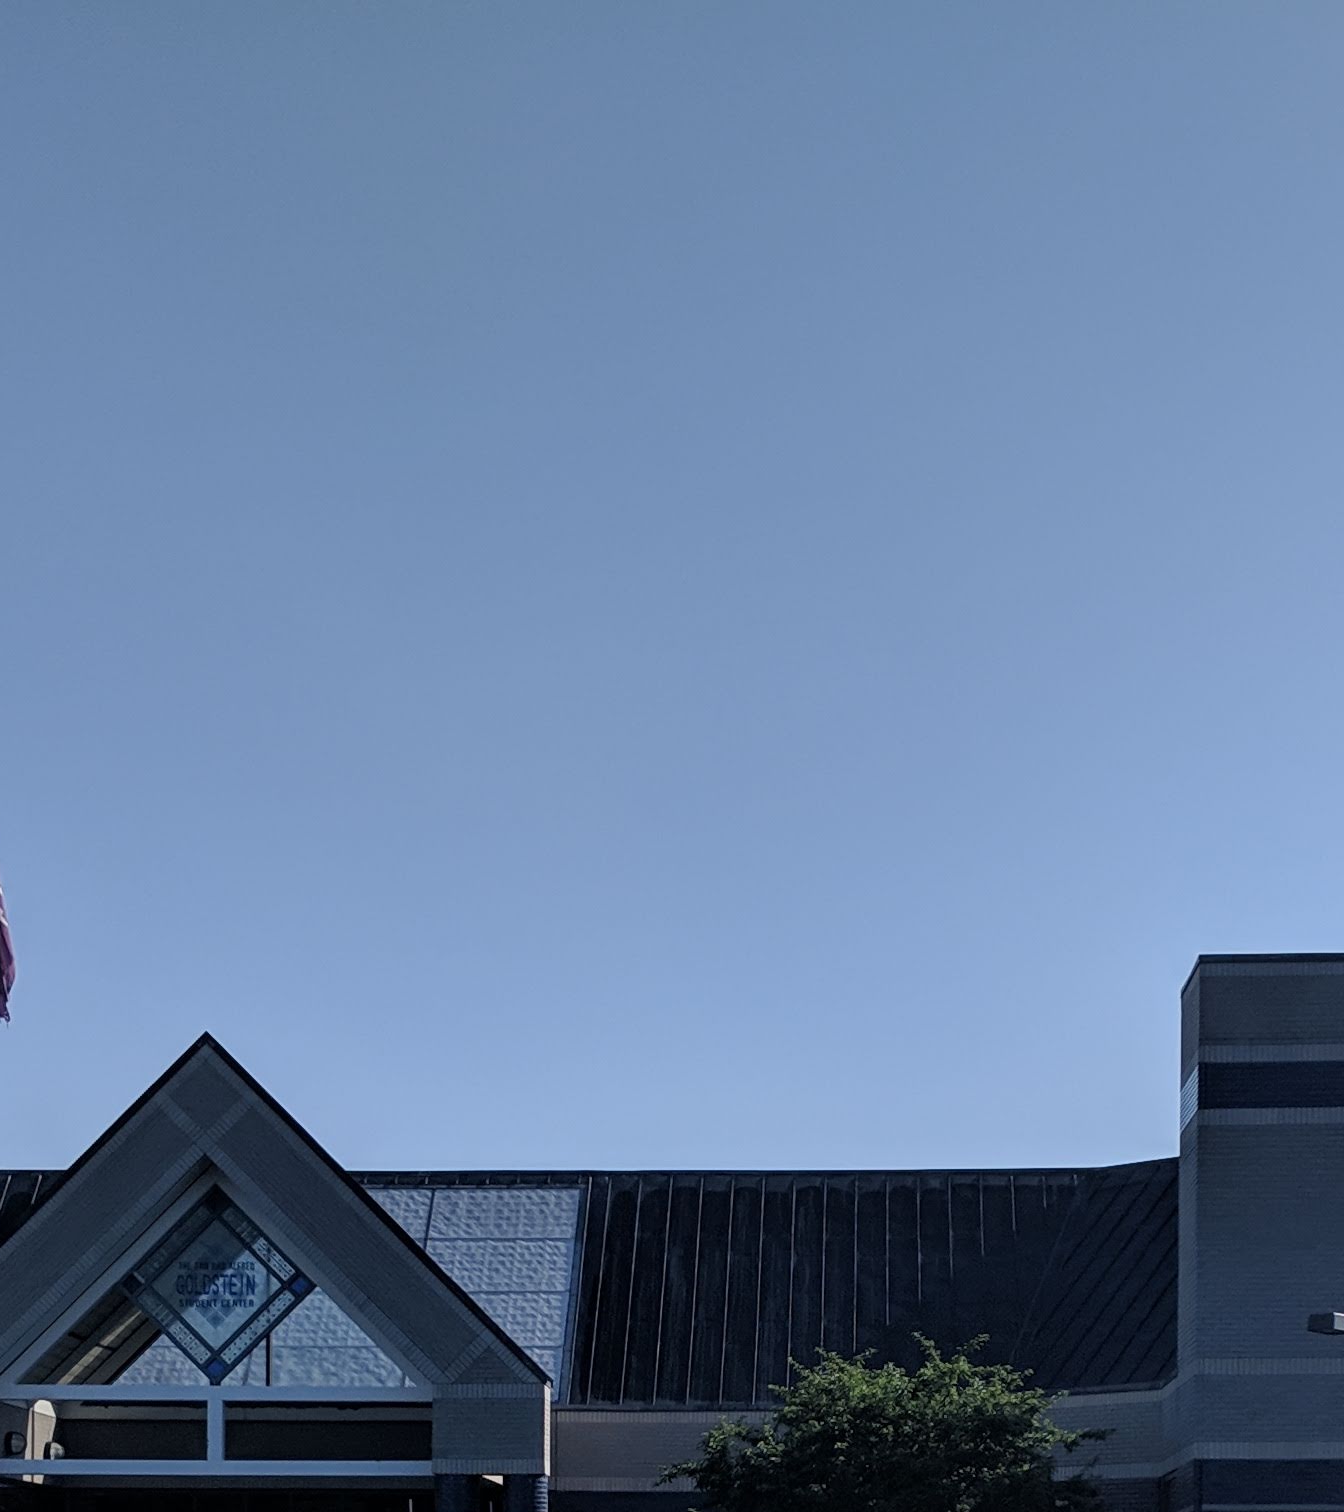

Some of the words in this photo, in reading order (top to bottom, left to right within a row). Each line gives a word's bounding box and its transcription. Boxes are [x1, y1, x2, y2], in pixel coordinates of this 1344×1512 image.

[176, 1274, 256, 1296] GOLDSTEIN
[179, 1299, 217, 1308] STUDENT
[221, 1299, 254, 1308] CENTER
